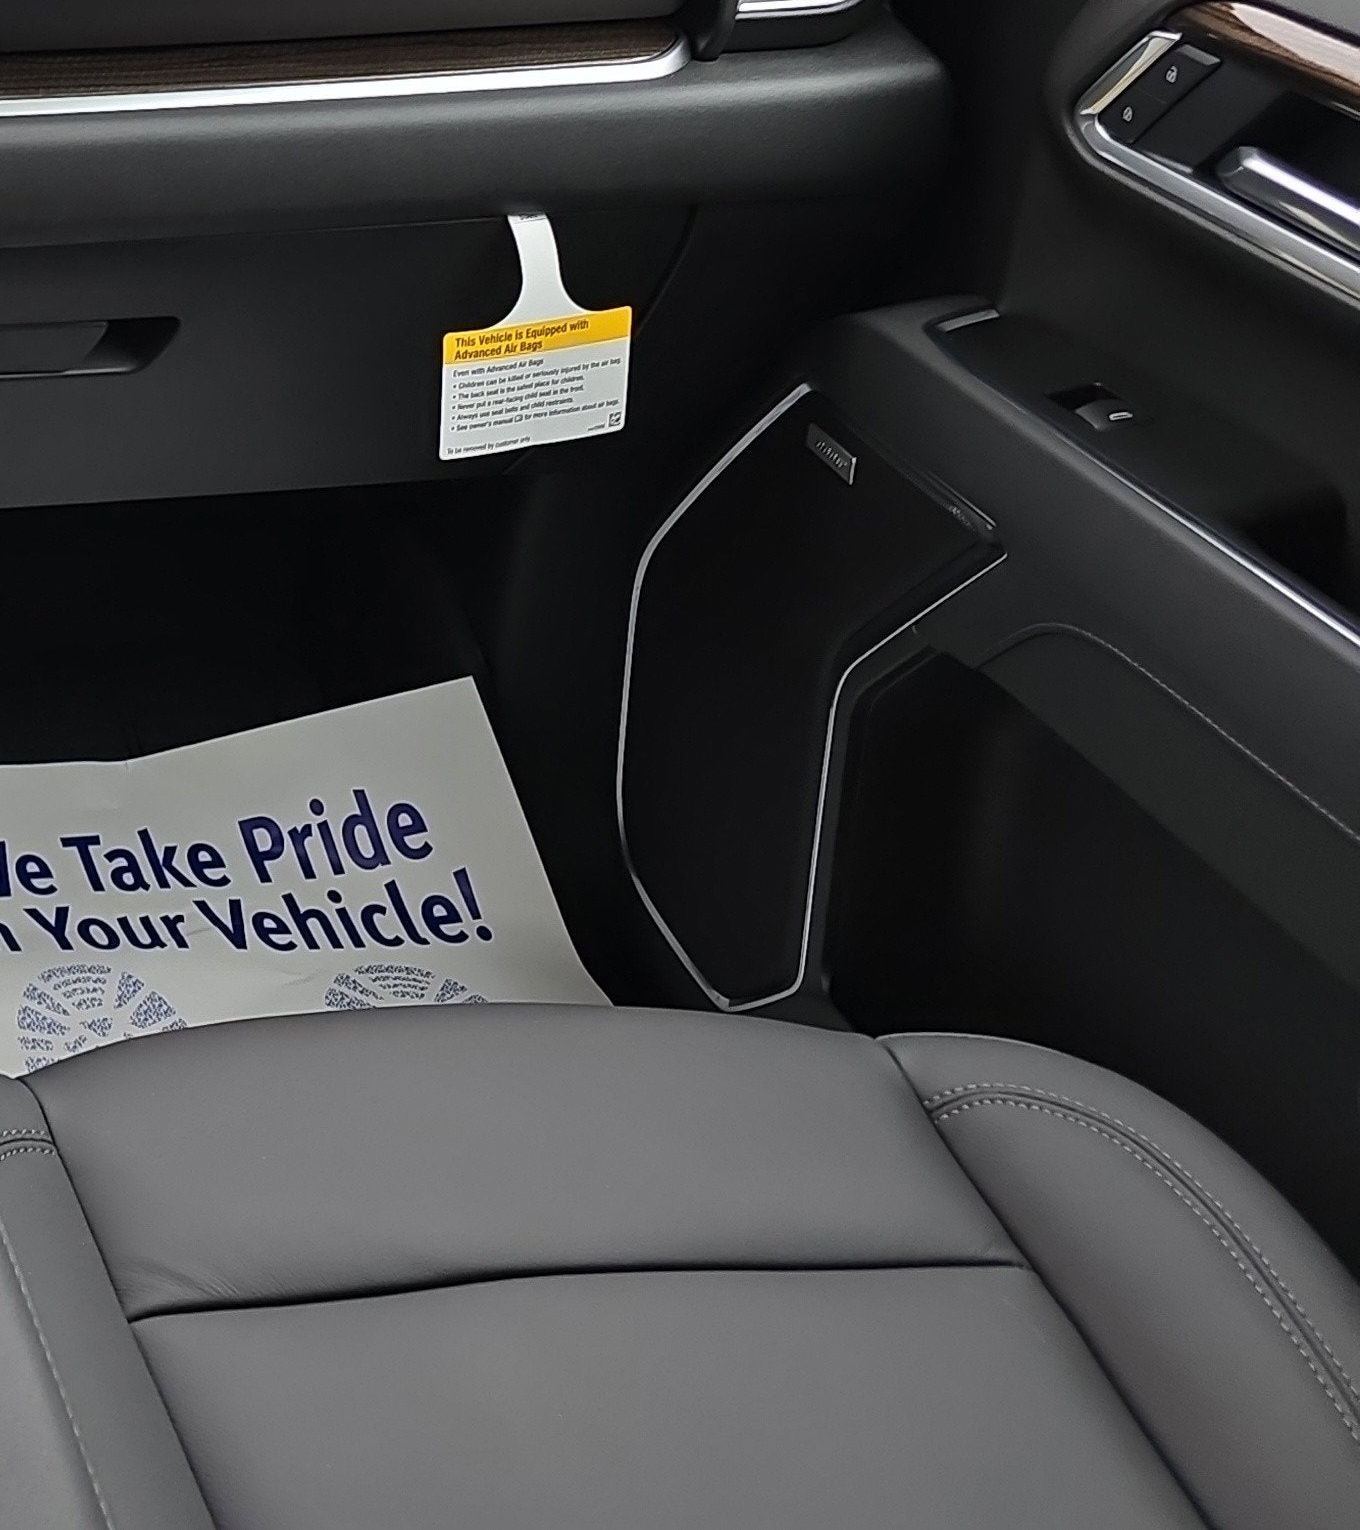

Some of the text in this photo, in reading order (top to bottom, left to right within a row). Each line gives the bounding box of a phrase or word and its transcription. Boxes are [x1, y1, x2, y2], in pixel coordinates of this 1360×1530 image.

[456, 319, 589, 347] This Vehicle is Equipped with
[454, 341, 542, 360] Advanced Air Bags
[487, 363, 517, 373] Advanced
[529, 359, 543, 367] Bags
[459, 381, 484, 389] Children
[61, 828, 228, 894] Take
[238, 787, 435, 884] Pride
[23, 905, 187, 955] Your
[193, 866, 493, 954] Vehicle!
